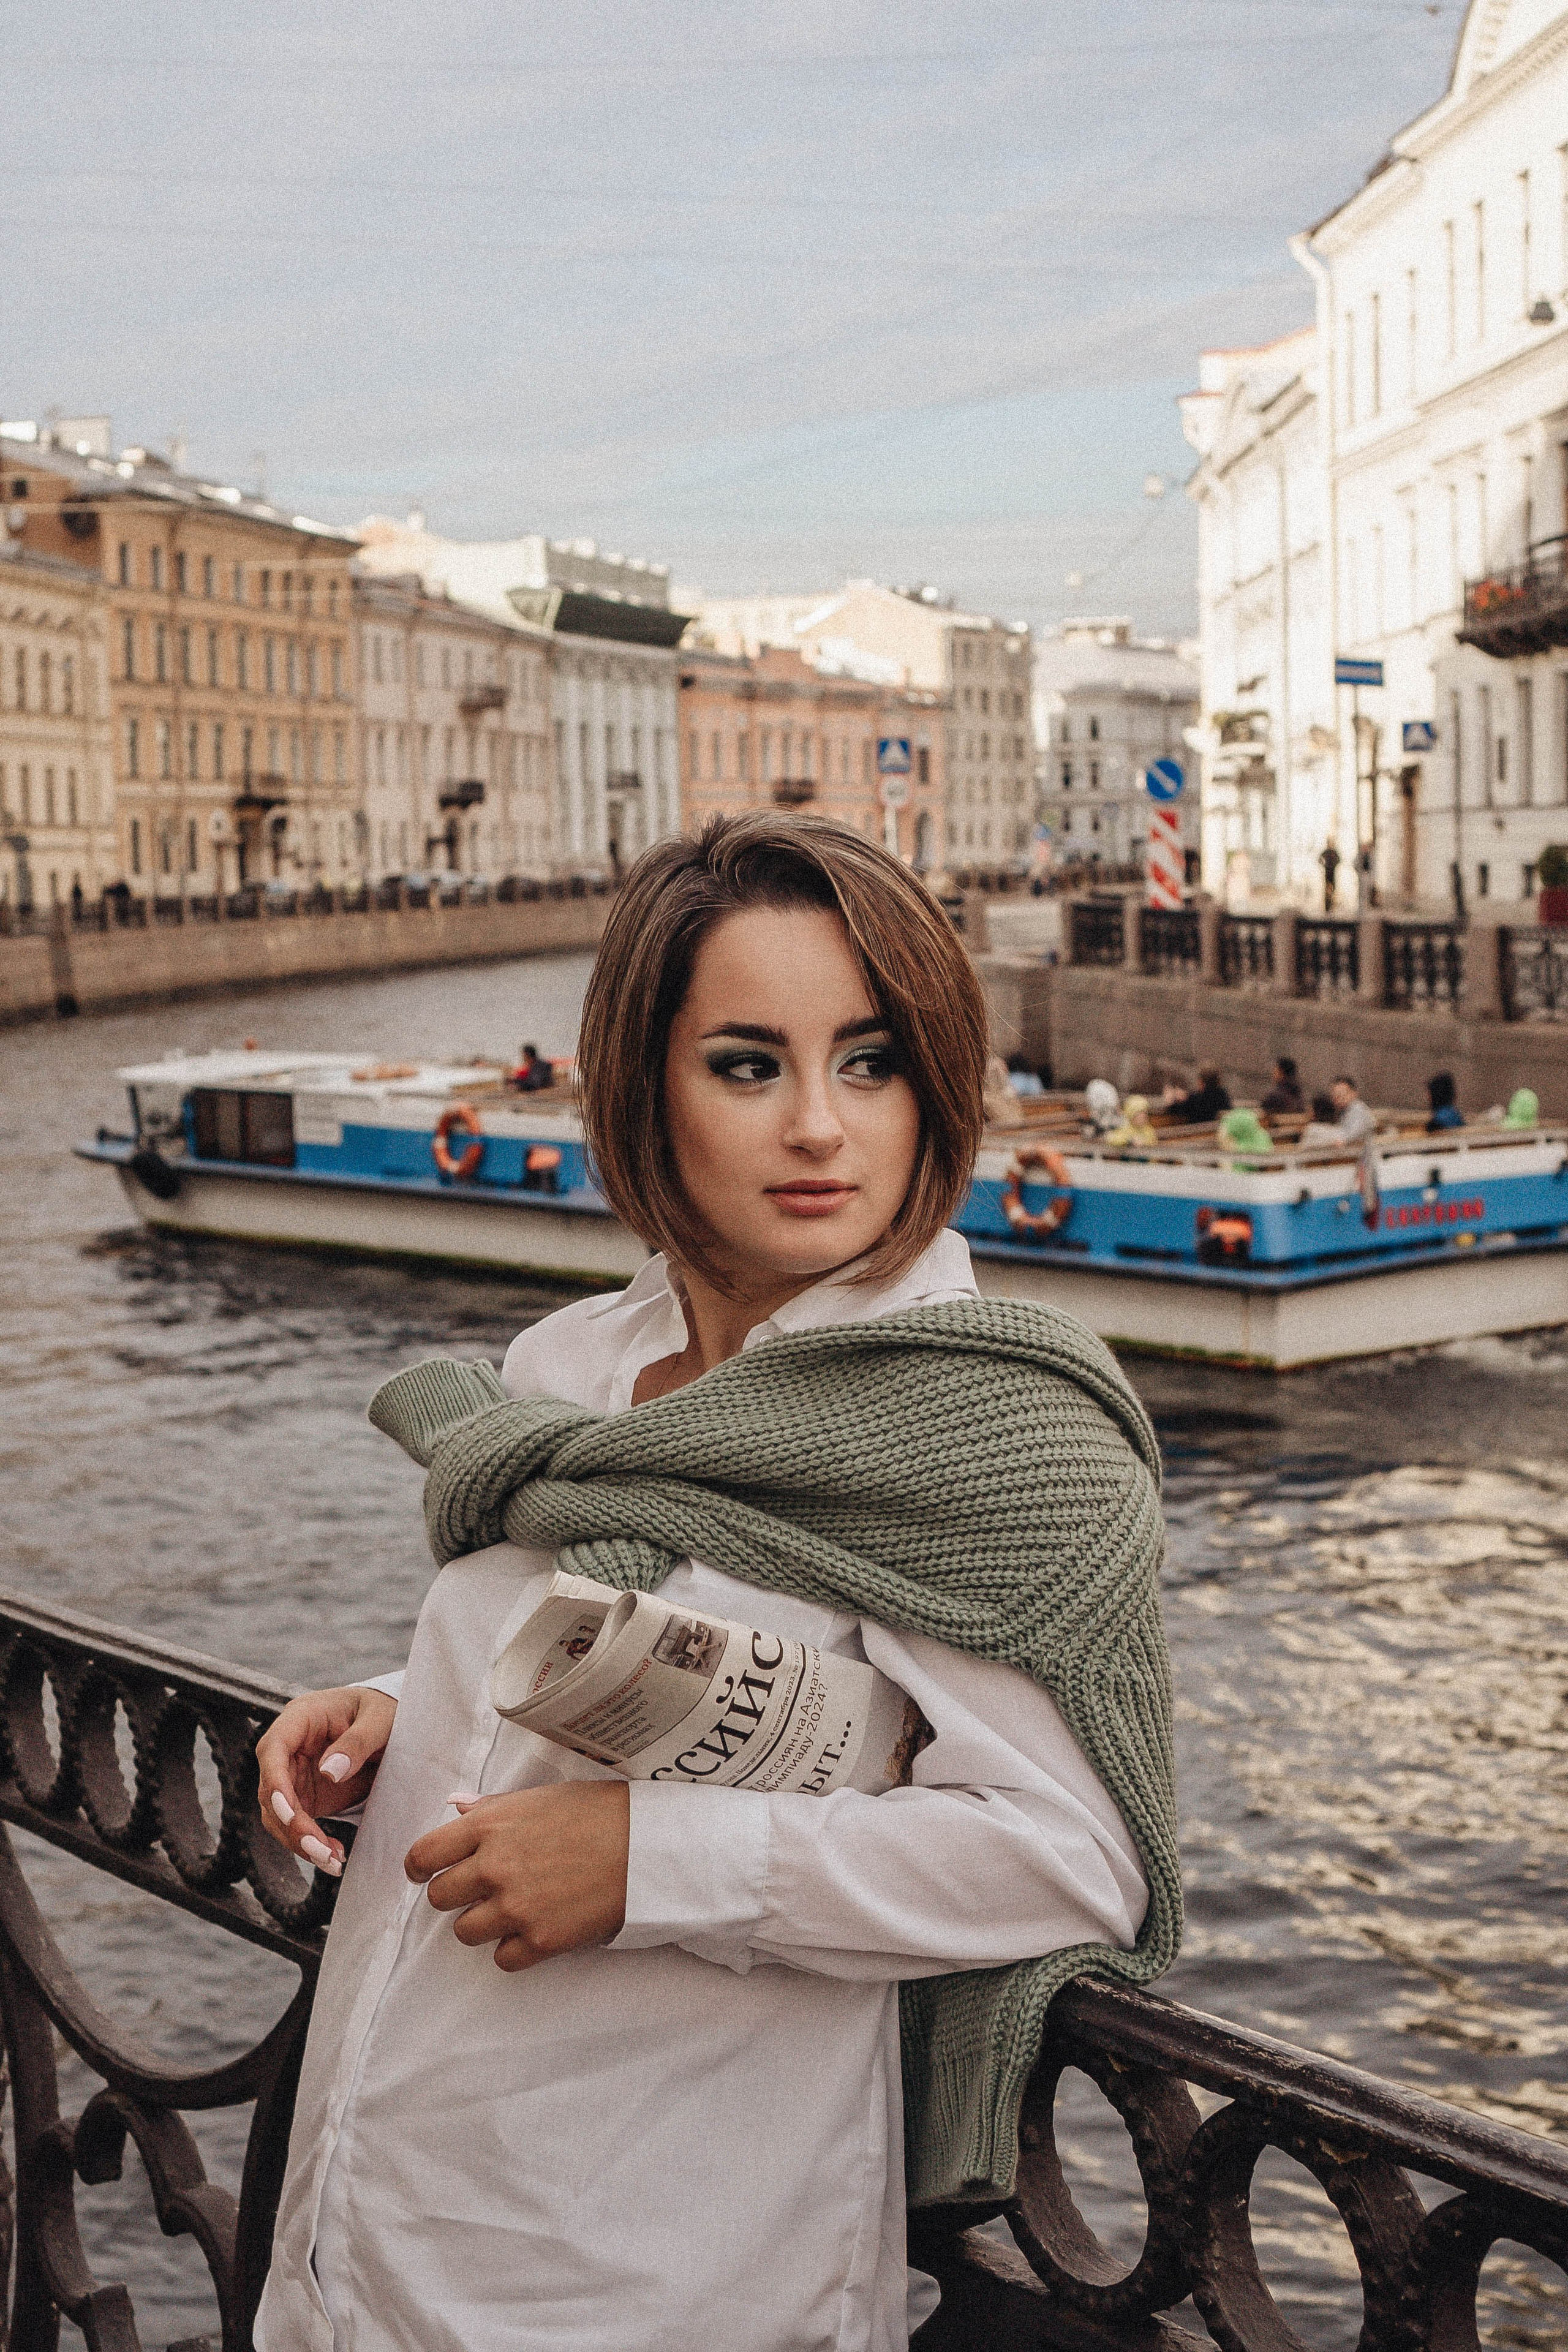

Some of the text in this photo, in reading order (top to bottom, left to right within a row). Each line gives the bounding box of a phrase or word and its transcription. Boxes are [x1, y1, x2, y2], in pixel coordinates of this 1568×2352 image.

[605, 1693, 621, 1708] это
[619, 1659, 652, 1695] колесо?
[736, 1738, 774, 1775] Понедельник,
[774, 1695, 790, 1732] сентября
[786, 1674, 796, 1695] 2023.
[756, 1738, 798, 1787] россиян
[794, 1718, 807, 1736] на
[766, 1683, 828, 1793] лимпиаду-2024?
[796, 1721, 851, 1794] ЫТ...
